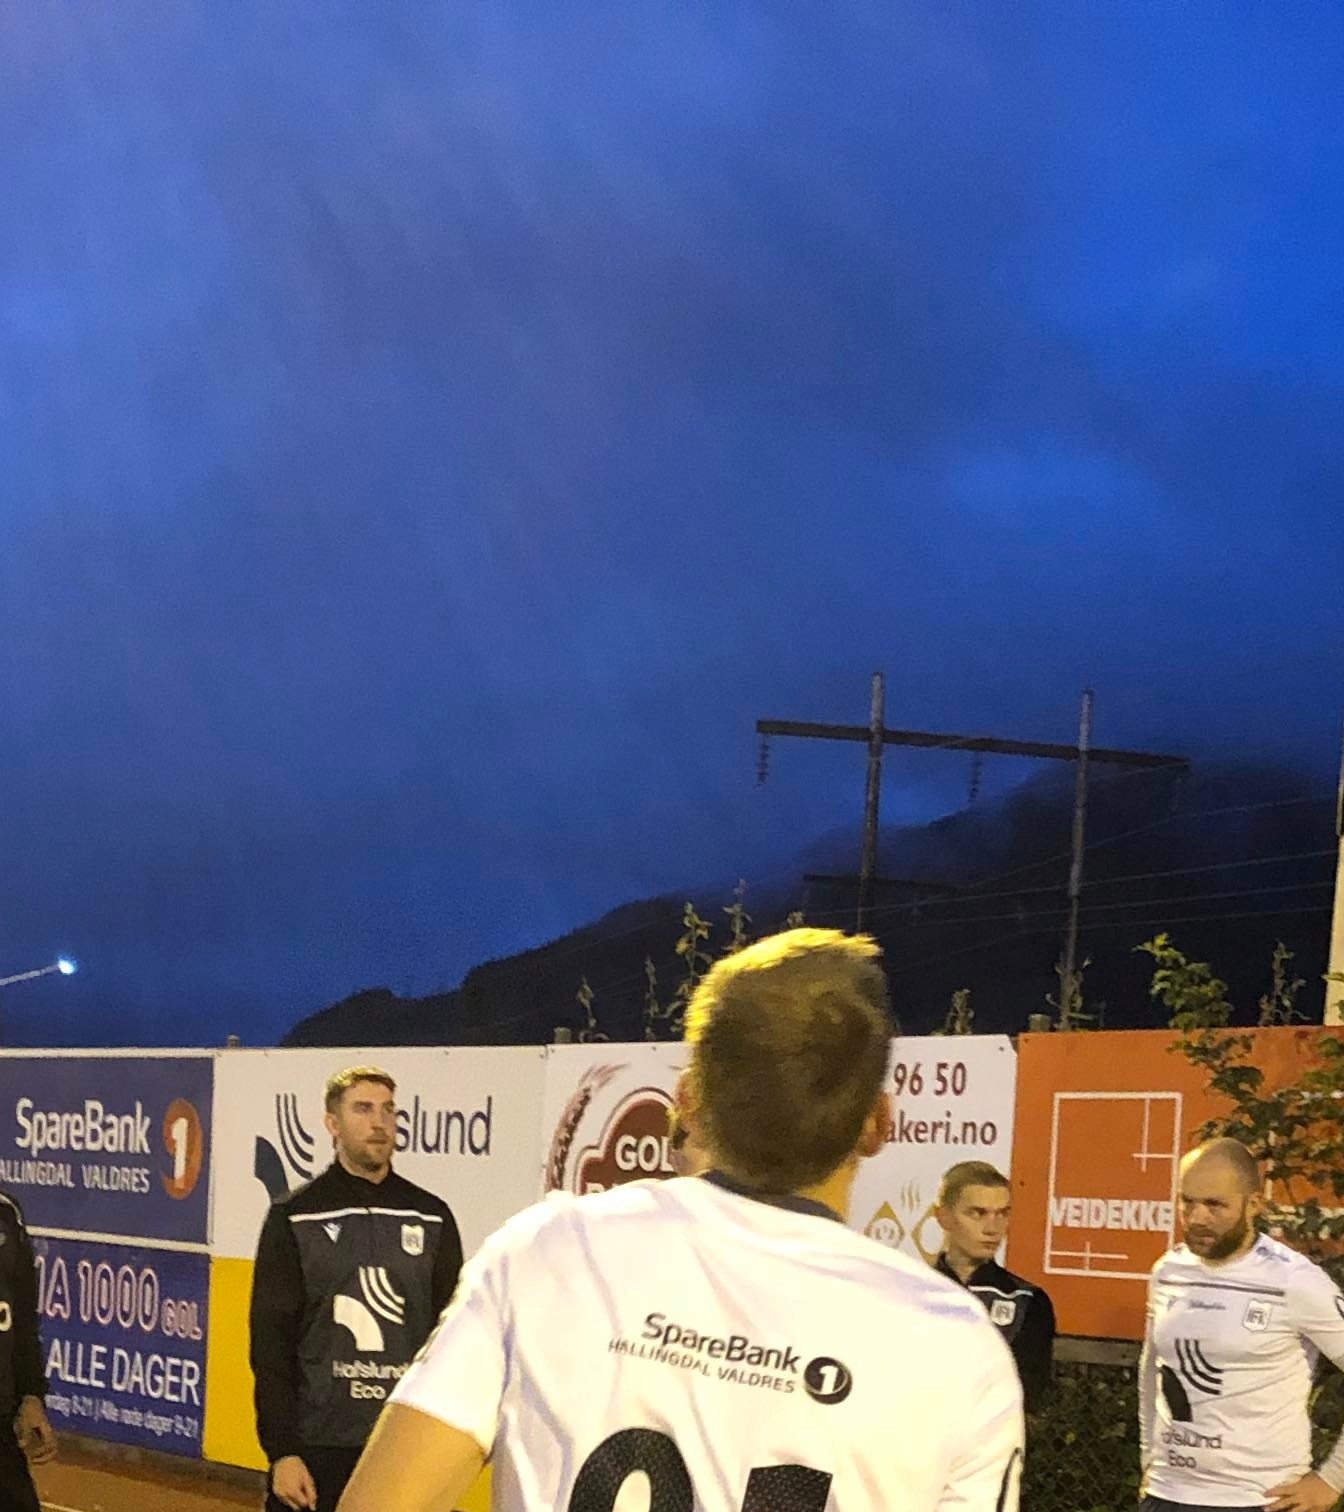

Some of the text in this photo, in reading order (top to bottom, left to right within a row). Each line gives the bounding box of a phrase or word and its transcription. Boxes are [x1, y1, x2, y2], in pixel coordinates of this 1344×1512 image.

[893, 1061, 967, 1097] 96 50
[15, 1097, 152, 1158] SpareBank
[395, 1095, 493, 1156] slund
[886, 1110, 998, 1146] akeri.no
[81, 1164, 151, 1194] VALDRES
[1050, 1197, 1175, 1234] VEIDEKKE
[78, 1260, 160, 1332] 1000
[45, 1338, 201, 1407] ALLE DAGER
[607, 1337, 798, 1394] HALLINGDAL VALDRES
[641, 1312, 802, 1375] SpareBank
